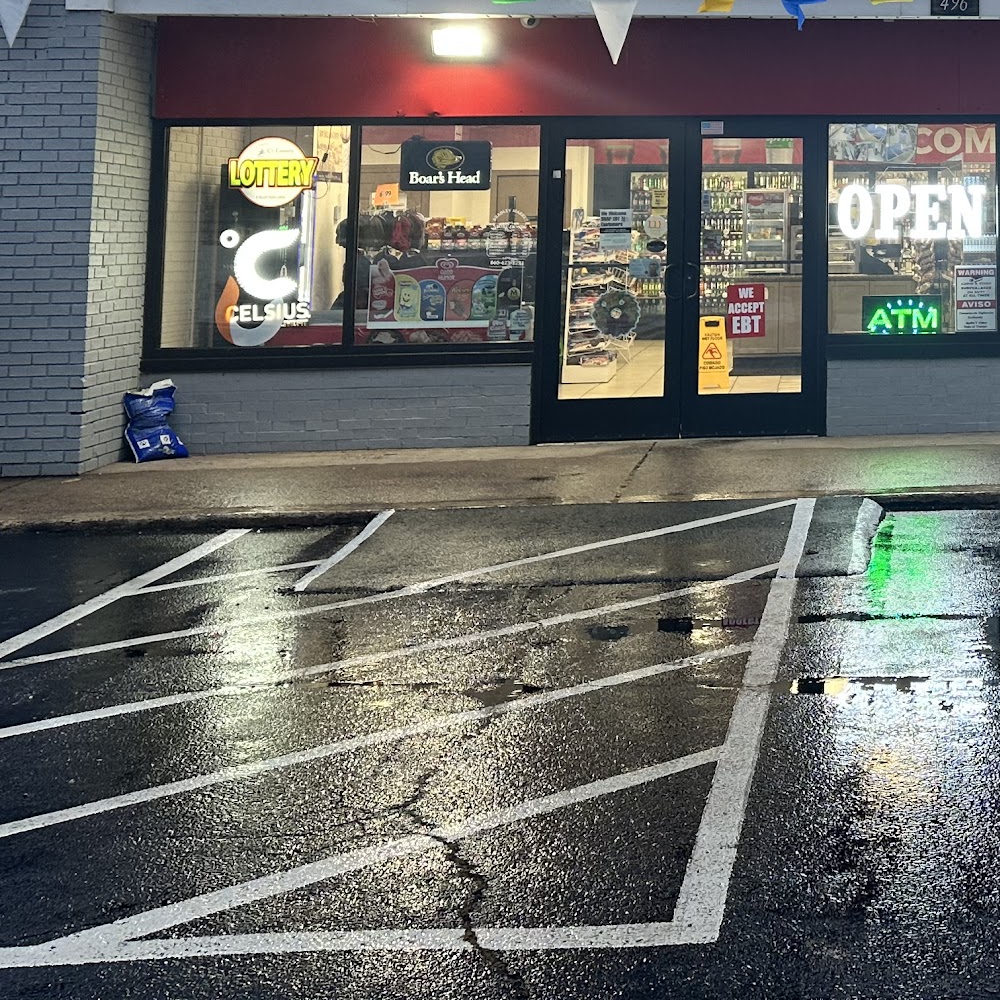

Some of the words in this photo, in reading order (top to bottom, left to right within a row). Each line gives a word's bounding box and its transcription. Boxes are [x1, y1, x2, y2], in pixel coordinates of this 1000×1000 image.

[229, 159, 315, 187] LOTTERY
[409, 171, 445, 184] Boar's
[447, 170, 480, 184] Head
[837, 184, 986, 240] OPEN
[738, 287, 754, 299] WE
[225, 302, 309, 322] CELSIUS
[728, 302, 764, 314] ACCEPT
[732, 315, 762, 334] EBT
[866, 308, 938, 329] ATM
